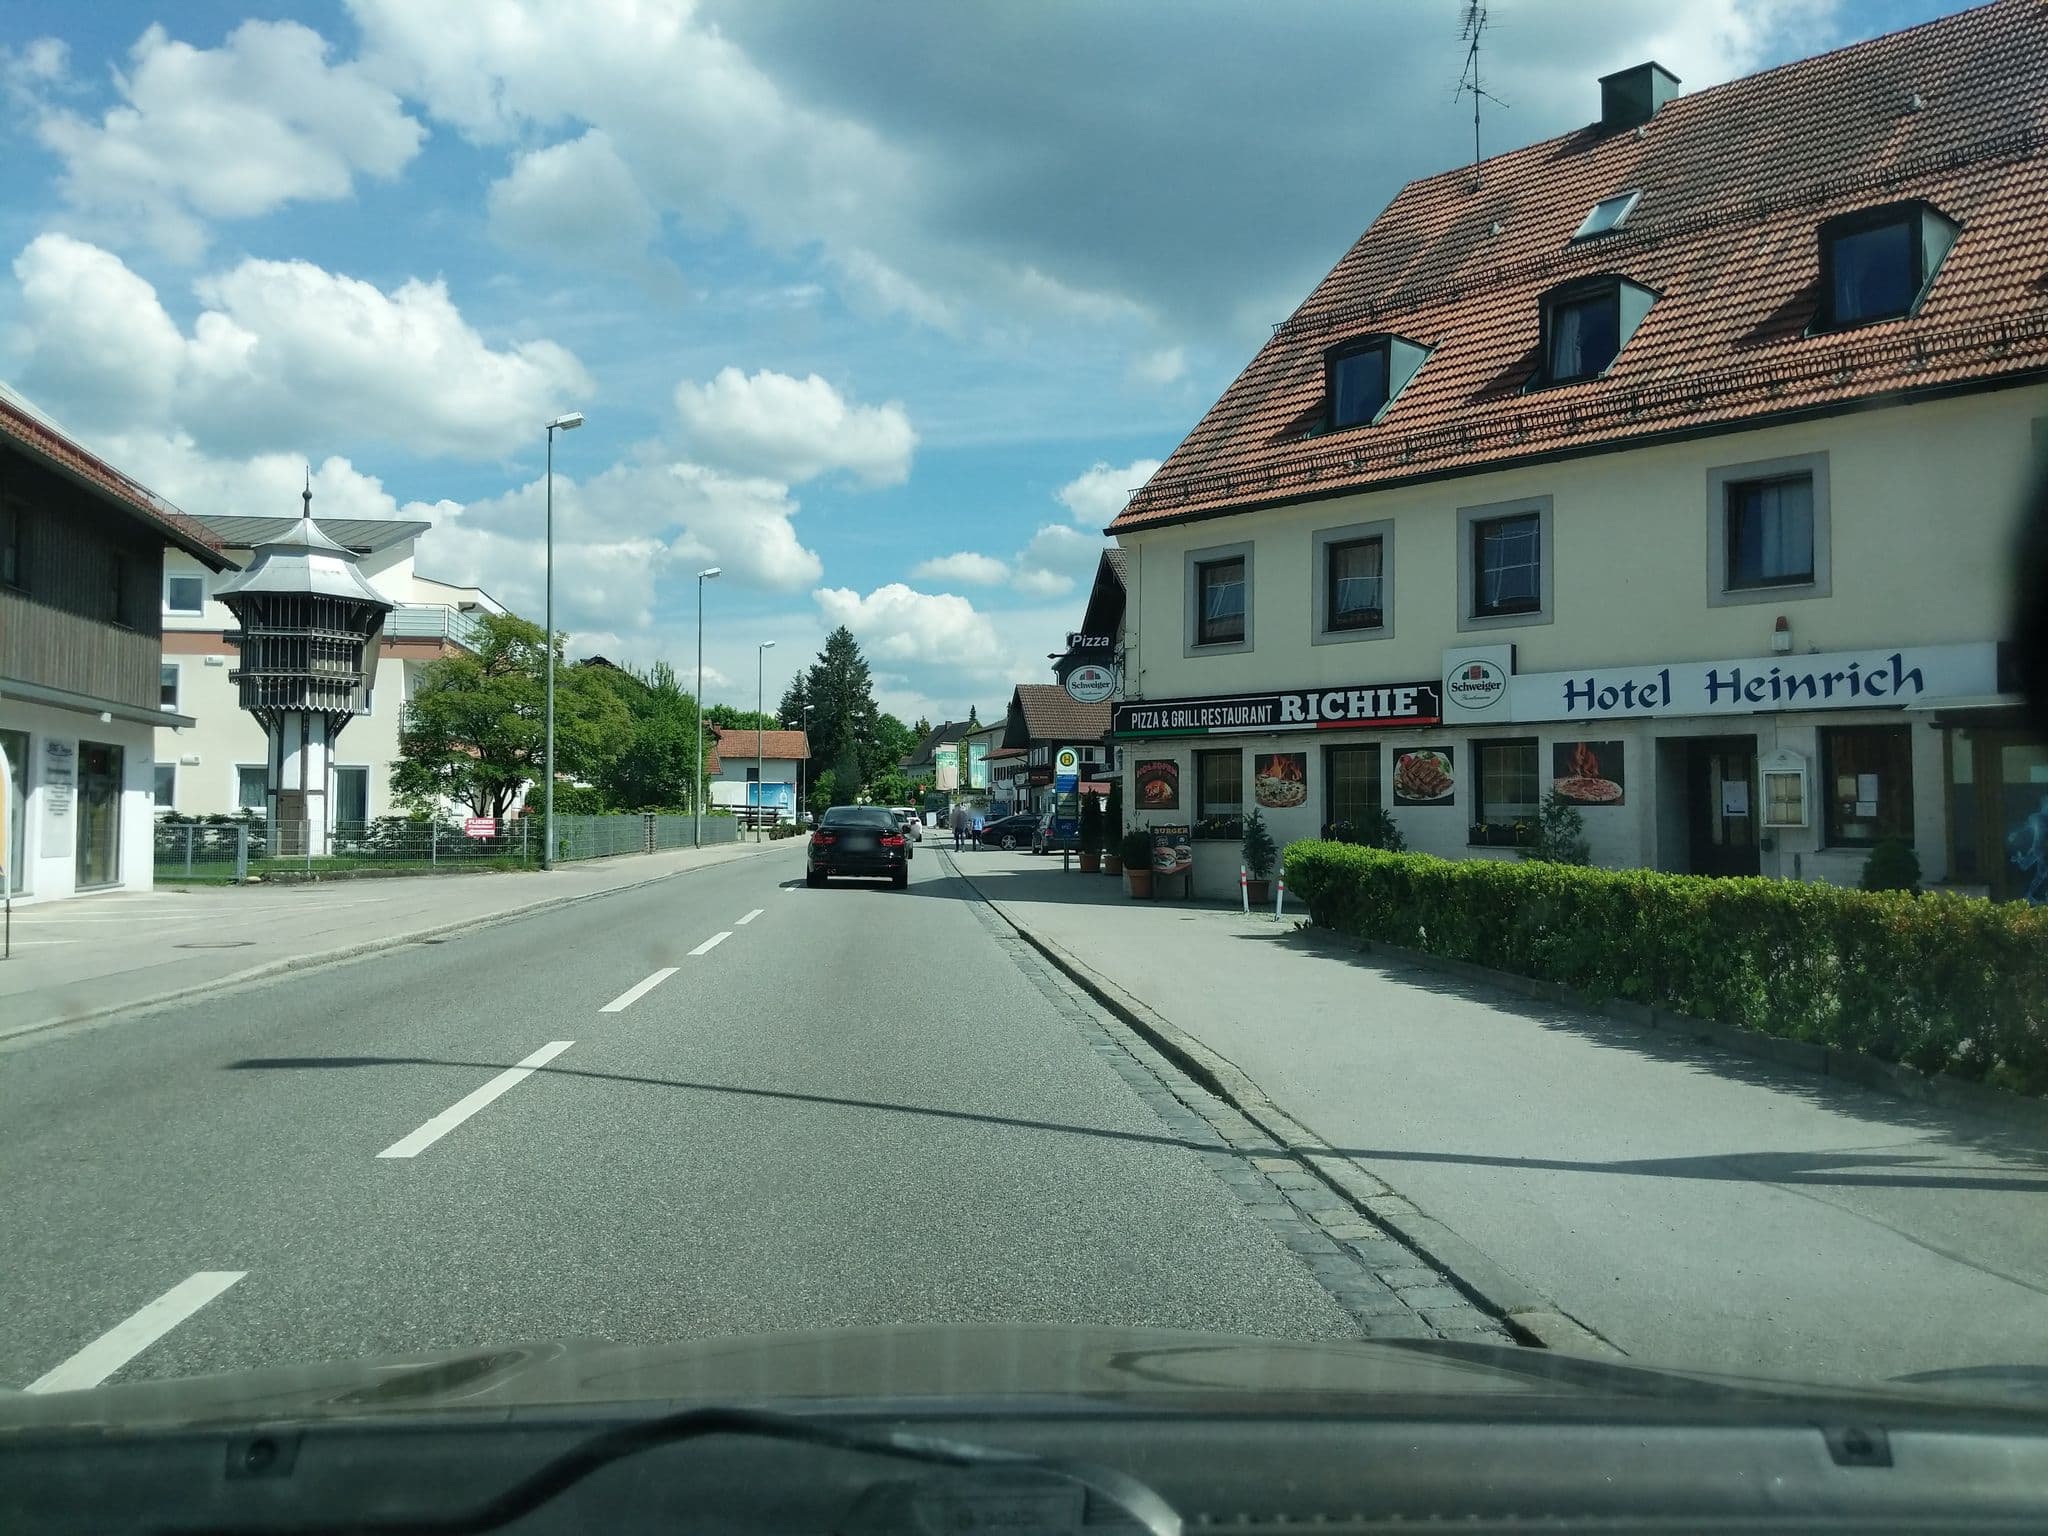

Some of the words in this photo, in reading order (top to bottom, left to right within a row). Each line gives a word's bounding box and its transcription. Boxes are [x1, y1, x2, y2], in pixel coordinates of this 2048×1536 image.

[1072, 634, 1110, 648] Pizza
[1071, 681, 1110, 691] Schweiger
[1451, 681, 1502, 693] Schweiger
[1562, 668, 1671, 713] Hotel
[1704, 652, 1925, 706] Heinrich
[1131, 711, 1160, 729] PIZZA
[1161, 710, 1170, 728] &
[1279, 686, 1419, 722] RICHIE
[1154, 827, 1188, 835] BURGER
